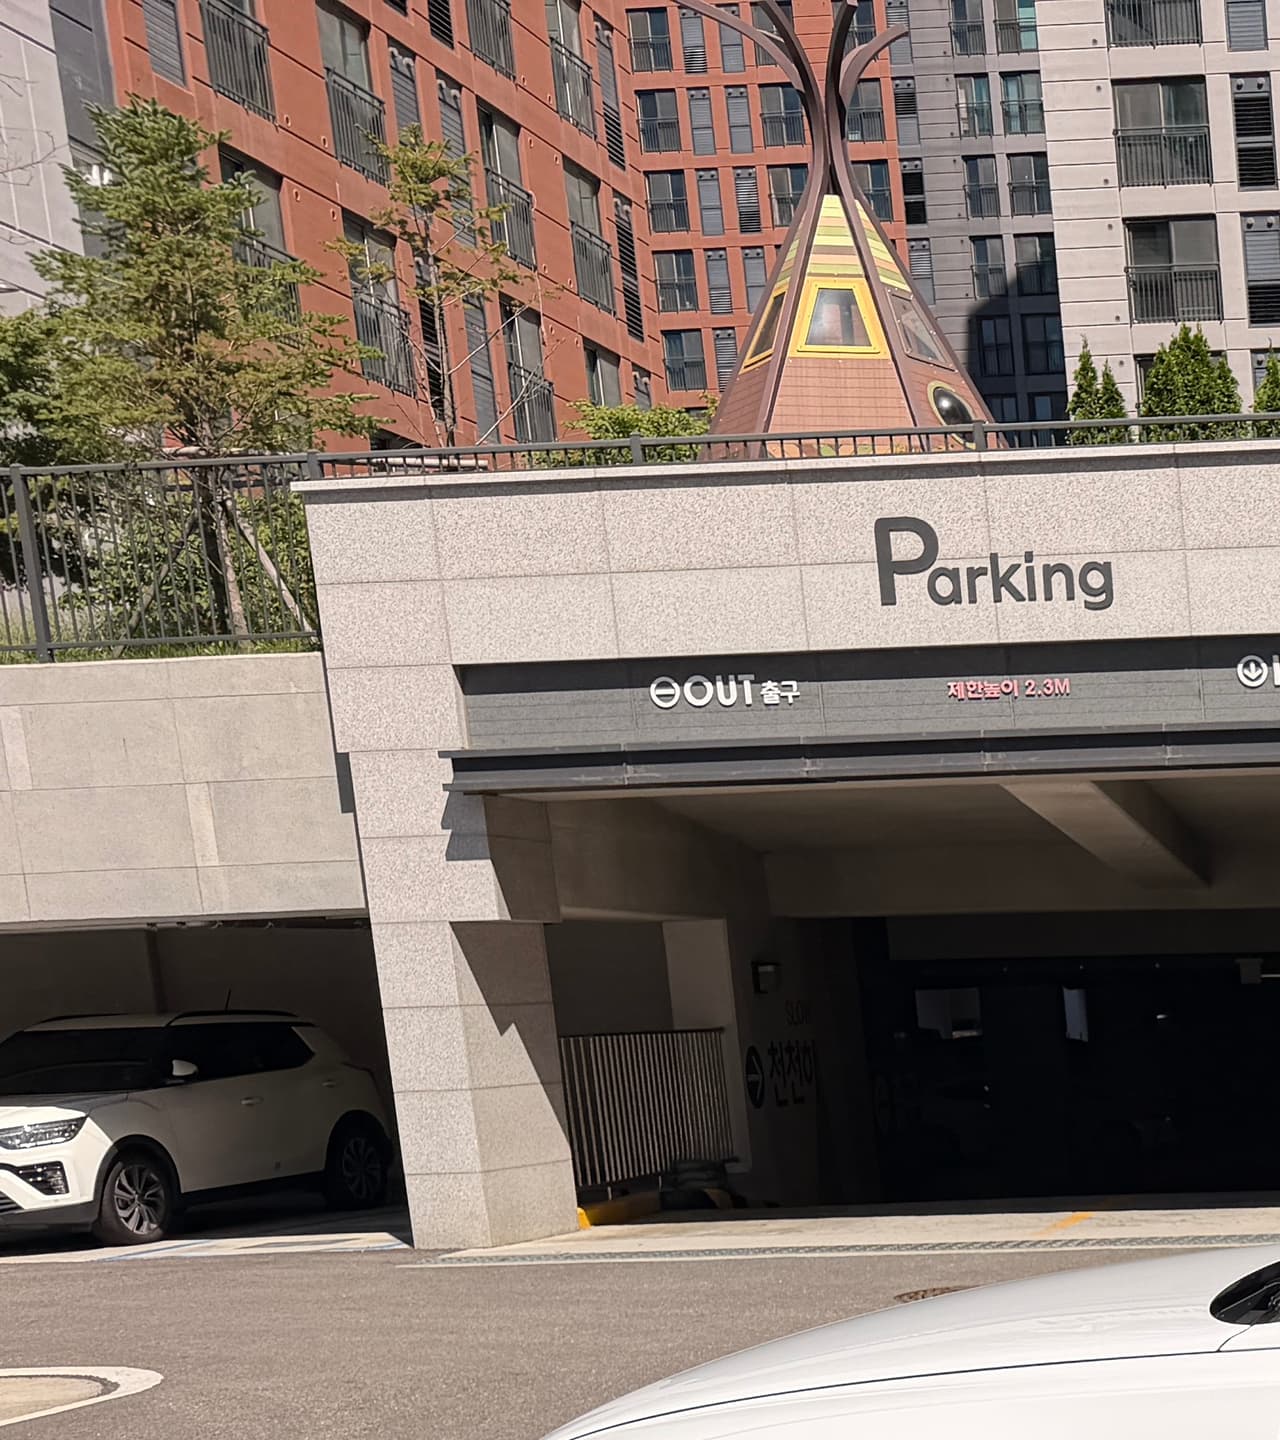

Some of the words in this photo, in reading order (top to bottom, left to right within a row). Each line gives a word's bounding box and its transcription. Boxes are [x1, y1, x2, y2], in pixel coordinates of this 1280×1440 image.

[874, 516, 1114, 611] Parking
[683, 674, 755, 707] OUT
[760, 680, 801, 705] 출구
[946, 680, 1019, 700] 제한높이
[1024, 678, 1071, 697] 2.3M
